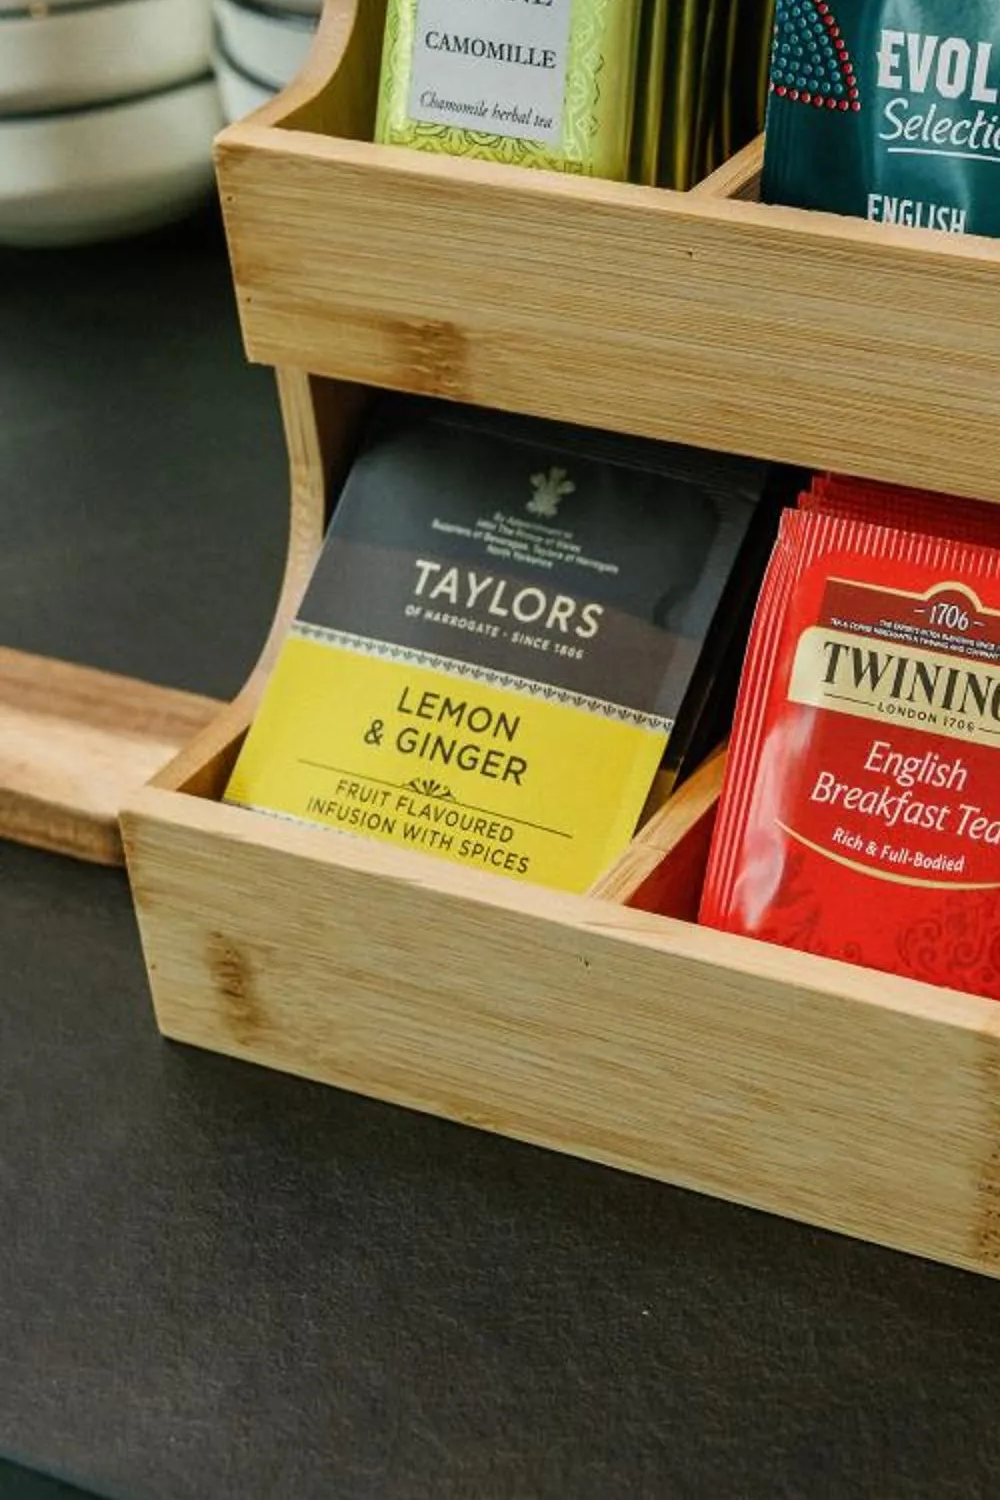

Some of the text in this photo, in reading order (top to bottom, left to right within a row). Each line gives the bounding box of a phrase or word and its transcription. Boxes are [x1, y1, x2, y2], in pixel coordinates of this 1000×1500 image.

[425, 30, 557, 69] CAMOMILLE
[420, 90, 552, 129] Chamomile herbal tea
[867, 193, 967, 233] ENGLISH
[415, 559, 605, 639] TAYLORS
[928, 602, 969, 632] 1706
[405, 605, 422, 618] OF
[424, 610, 501, 638] HARROGATE
[511, 631, 550, 651] SINCE
[397, 686, 521, 742] LEMON
[877, 702, 976, 733] LONDON 1706
[363, 719, 528, 786] & GINGER
[864, 740, 968, 792] English
[335, 779, 514, 844] FRUIT FLAVOURED
[811, 771, 951, 832] Breakfast
[306, 796, 531, 874] INFUSION WITH SPICES
[831, 827, 965, 873] Rich & Full-Bodied
